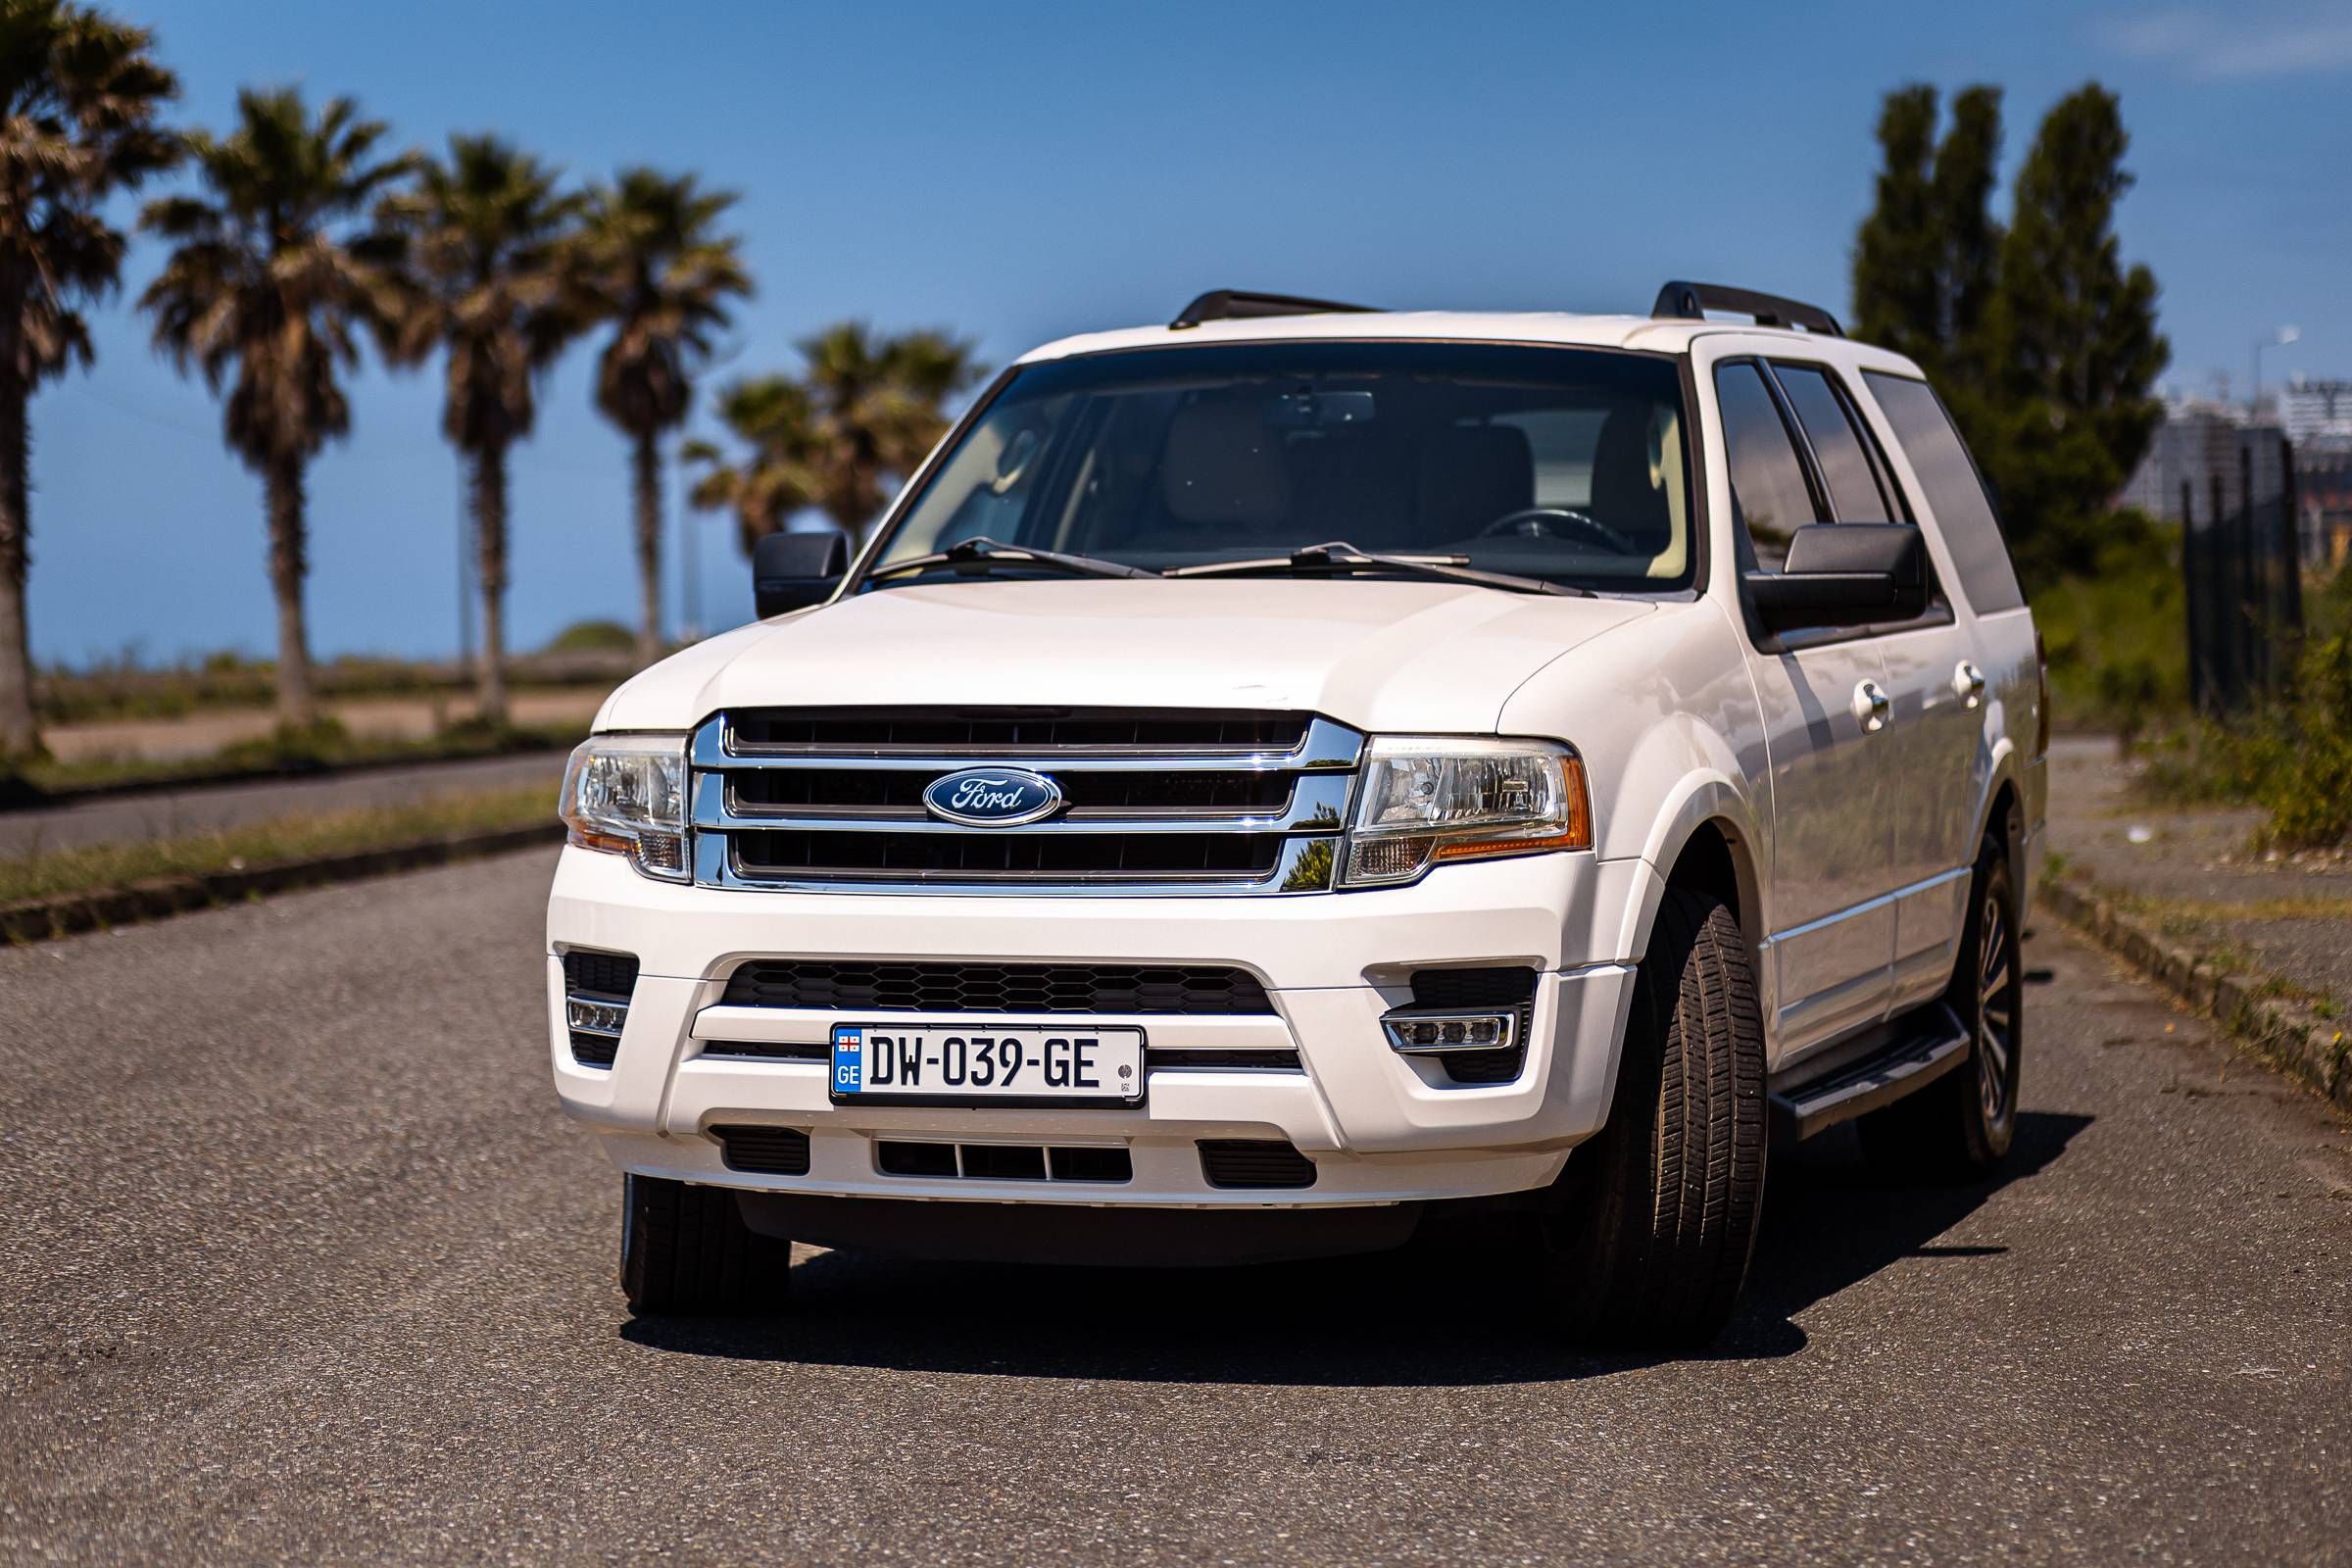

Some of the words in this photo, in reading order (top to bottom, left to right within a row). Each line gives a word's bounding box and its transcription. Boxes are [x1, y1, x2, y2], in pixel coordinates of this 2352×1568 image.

[952, 778, 1024, 808] Ford
[837, 1065, 859, 1085] GE
[869, 1036, 1100, 1088] DW-039-GE
